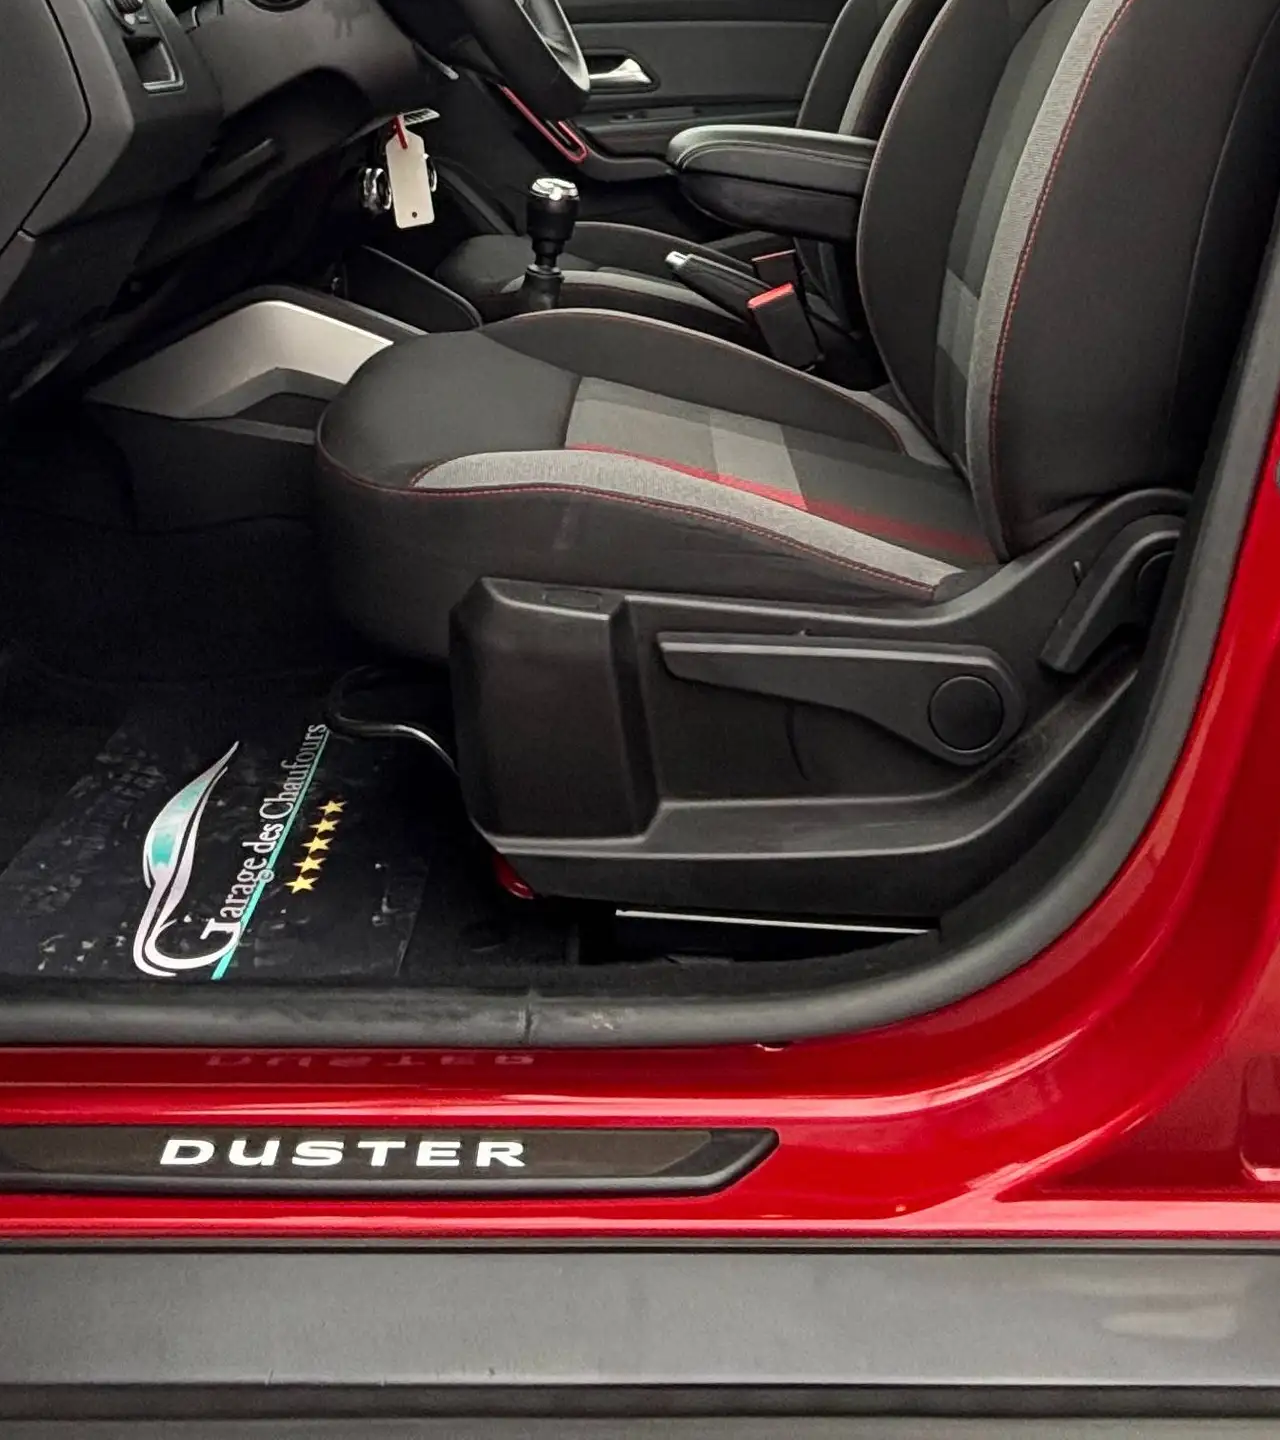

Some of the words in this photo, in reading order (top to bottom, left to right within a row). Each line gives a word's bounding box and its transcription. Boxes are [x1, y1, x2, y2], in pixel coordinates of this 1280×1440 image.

[260, 724, 327, 821] Chaufours
[243, 822, 285, 853] des
[144, 857, 275, 970] Garage
[160, 1139, 526, 1167] DUSTER
